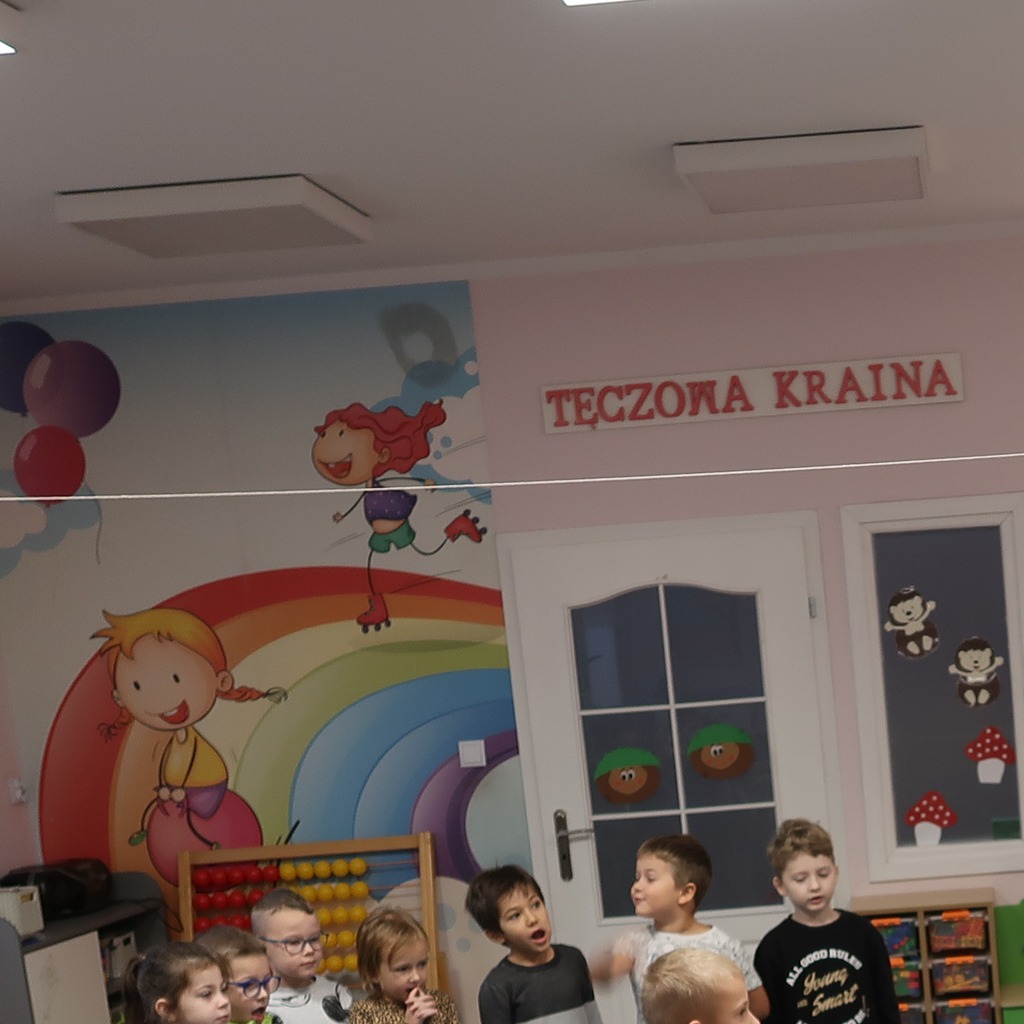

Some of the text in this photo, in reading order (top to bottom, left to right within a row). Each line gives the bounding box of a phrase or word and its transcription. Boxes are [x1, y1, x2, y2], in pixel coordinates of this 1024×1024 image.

[772, 359, 958, 410] KRAINA
[786, 948, 862, 986] ALL GOOD RULES
[803, 968, 848, 995] Young
